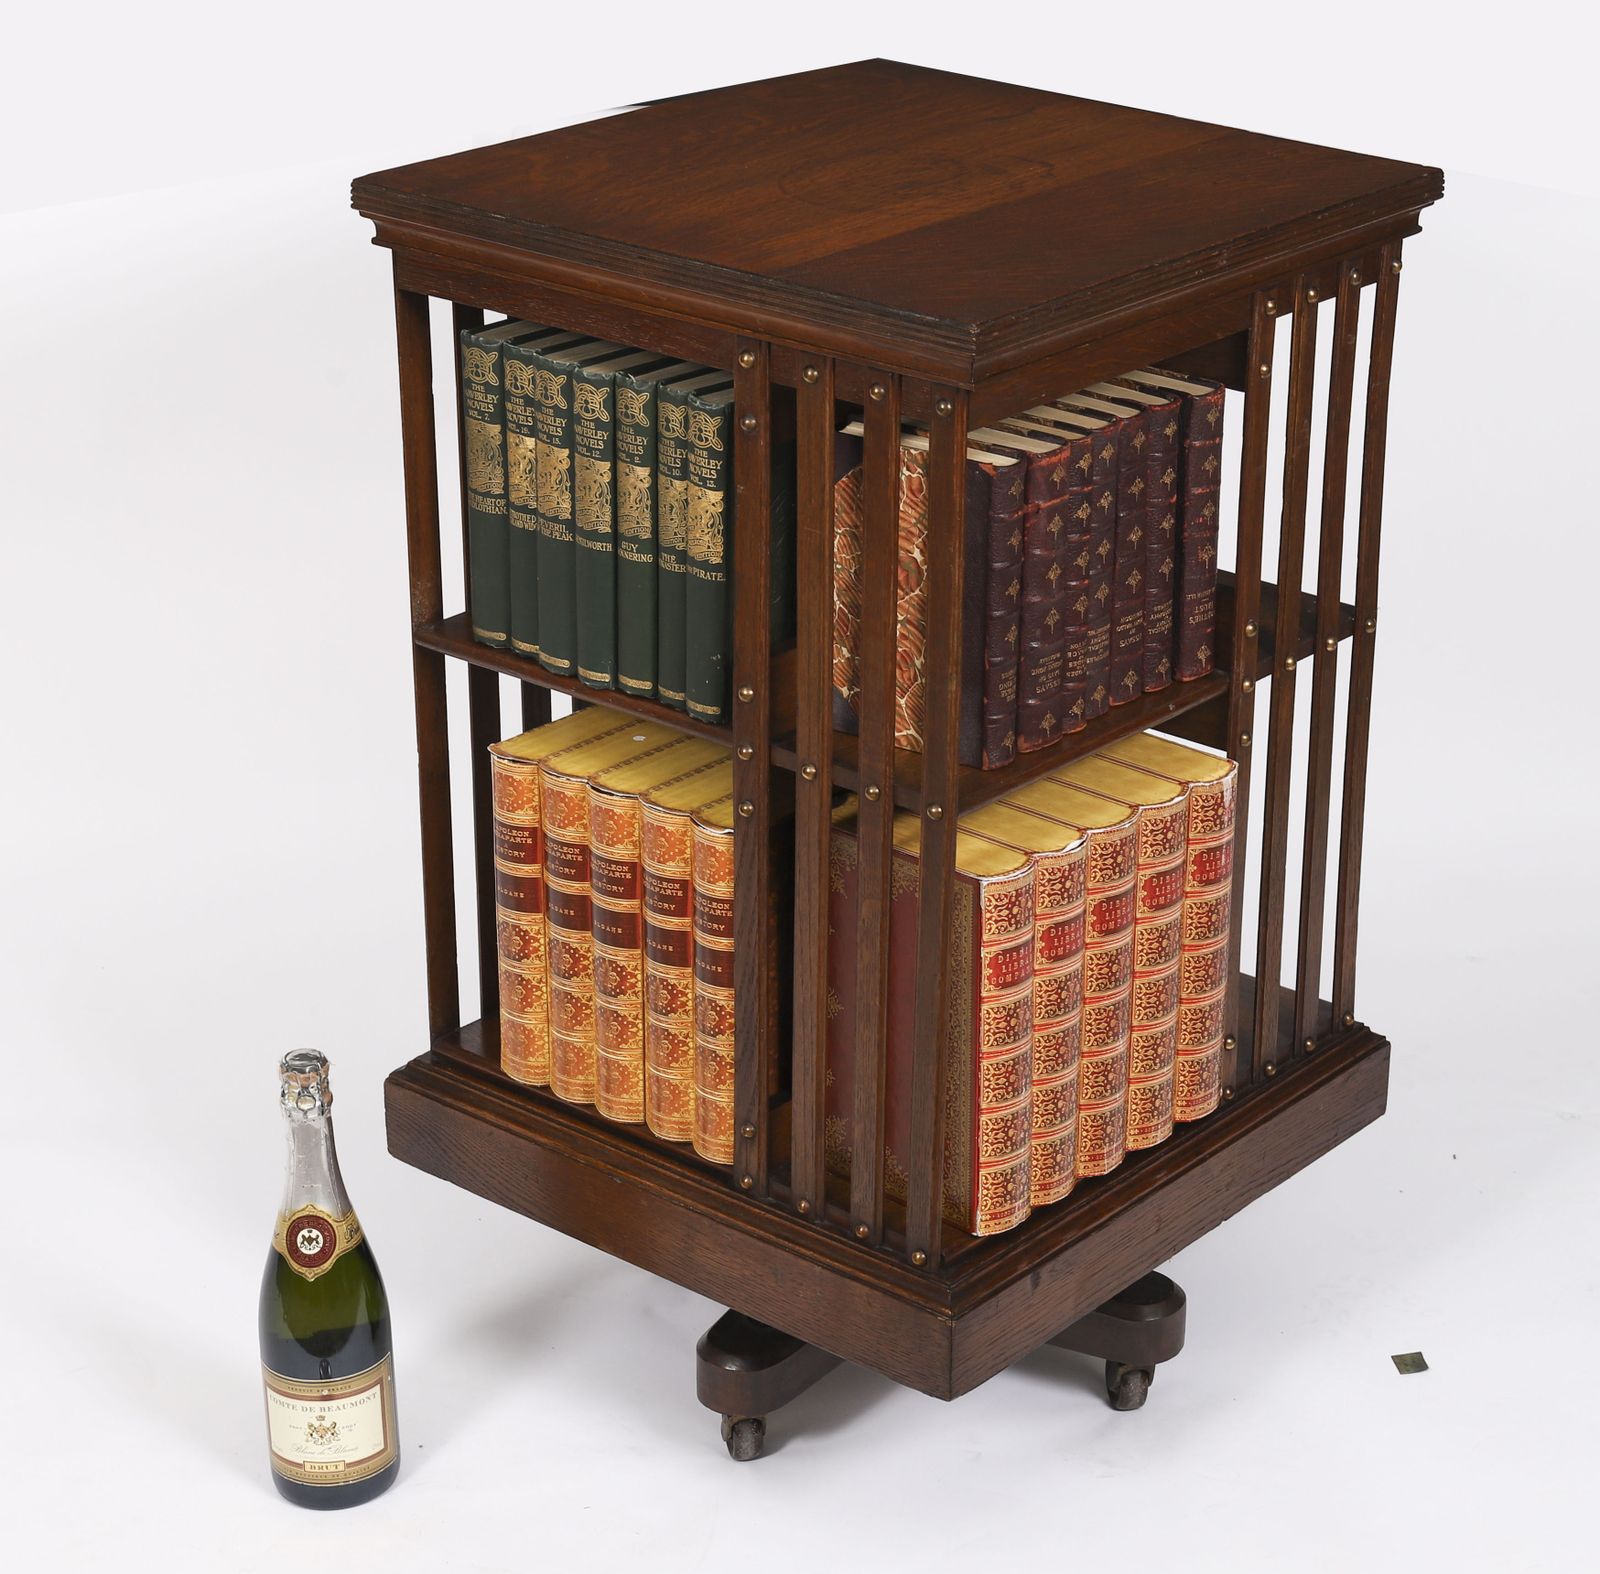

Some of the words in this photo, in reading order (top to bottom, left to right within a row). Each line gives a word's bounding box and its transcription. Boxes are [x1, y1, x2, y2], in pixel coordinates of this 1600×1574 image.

[472, 384, 485, 392] THE
[511, 396, 524, 405] THE
[582, 420, 595, 429] THE
[694, 448, 708, 457] THE
[672, 468, 682, 476] 10.
[496, 499, 506, 507] OF
[552, 531, 574, 541] PEAK
[622, 541, 638, 553] GUY
[662, 552, 676, 564] THE
[301, 1405, 316, 1413] DE
[319, 1392, 377, 1412] BEAUMONT
[309, 1463, 340, 1471] BRUT
